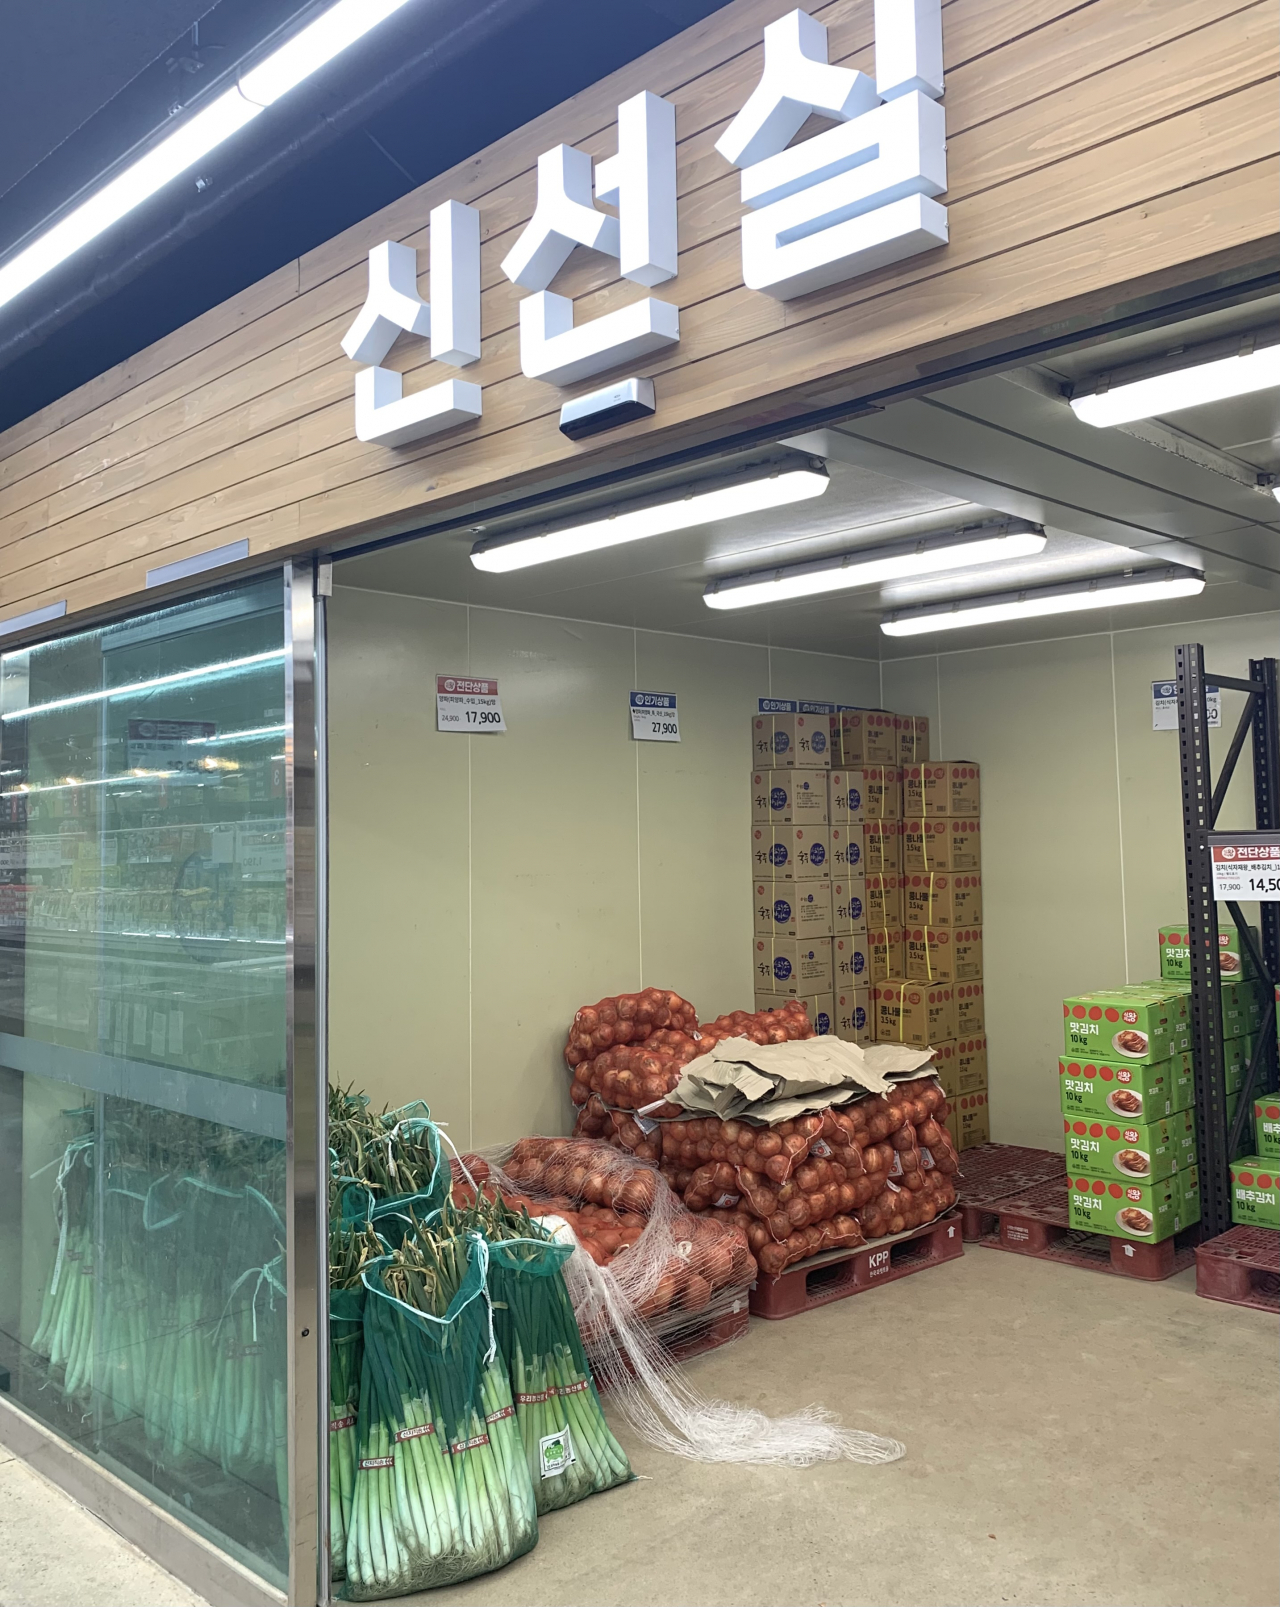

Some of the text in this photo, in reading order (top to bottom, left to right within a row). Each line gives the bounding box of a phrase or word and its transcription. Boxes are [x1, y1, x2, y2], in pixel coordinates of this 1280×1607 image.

[341, 0, 949, 446] 신선실
[456, 680, 488, 693] 전단상품
[645, 695, 669, 706] 인기상품
[770, 701, 791, 711] 인기상품
[466, 711, 500, 724] 17,900
[652, 722, 677, 734] 27,900
[1237, 846, 1280, 858] 전단상품
[1070, 1022, 1099, 1035] 맛김치
[1065, 1079, 1093, 1094] 맛김치
[1071, 1138, 1100, 1152] 맛김치
[1073, 1194, 1102, 1211] 맛김치
[1236, 1189, 1275, 1205] 배추김치
[869, 1250, 889, 1268] KPP
